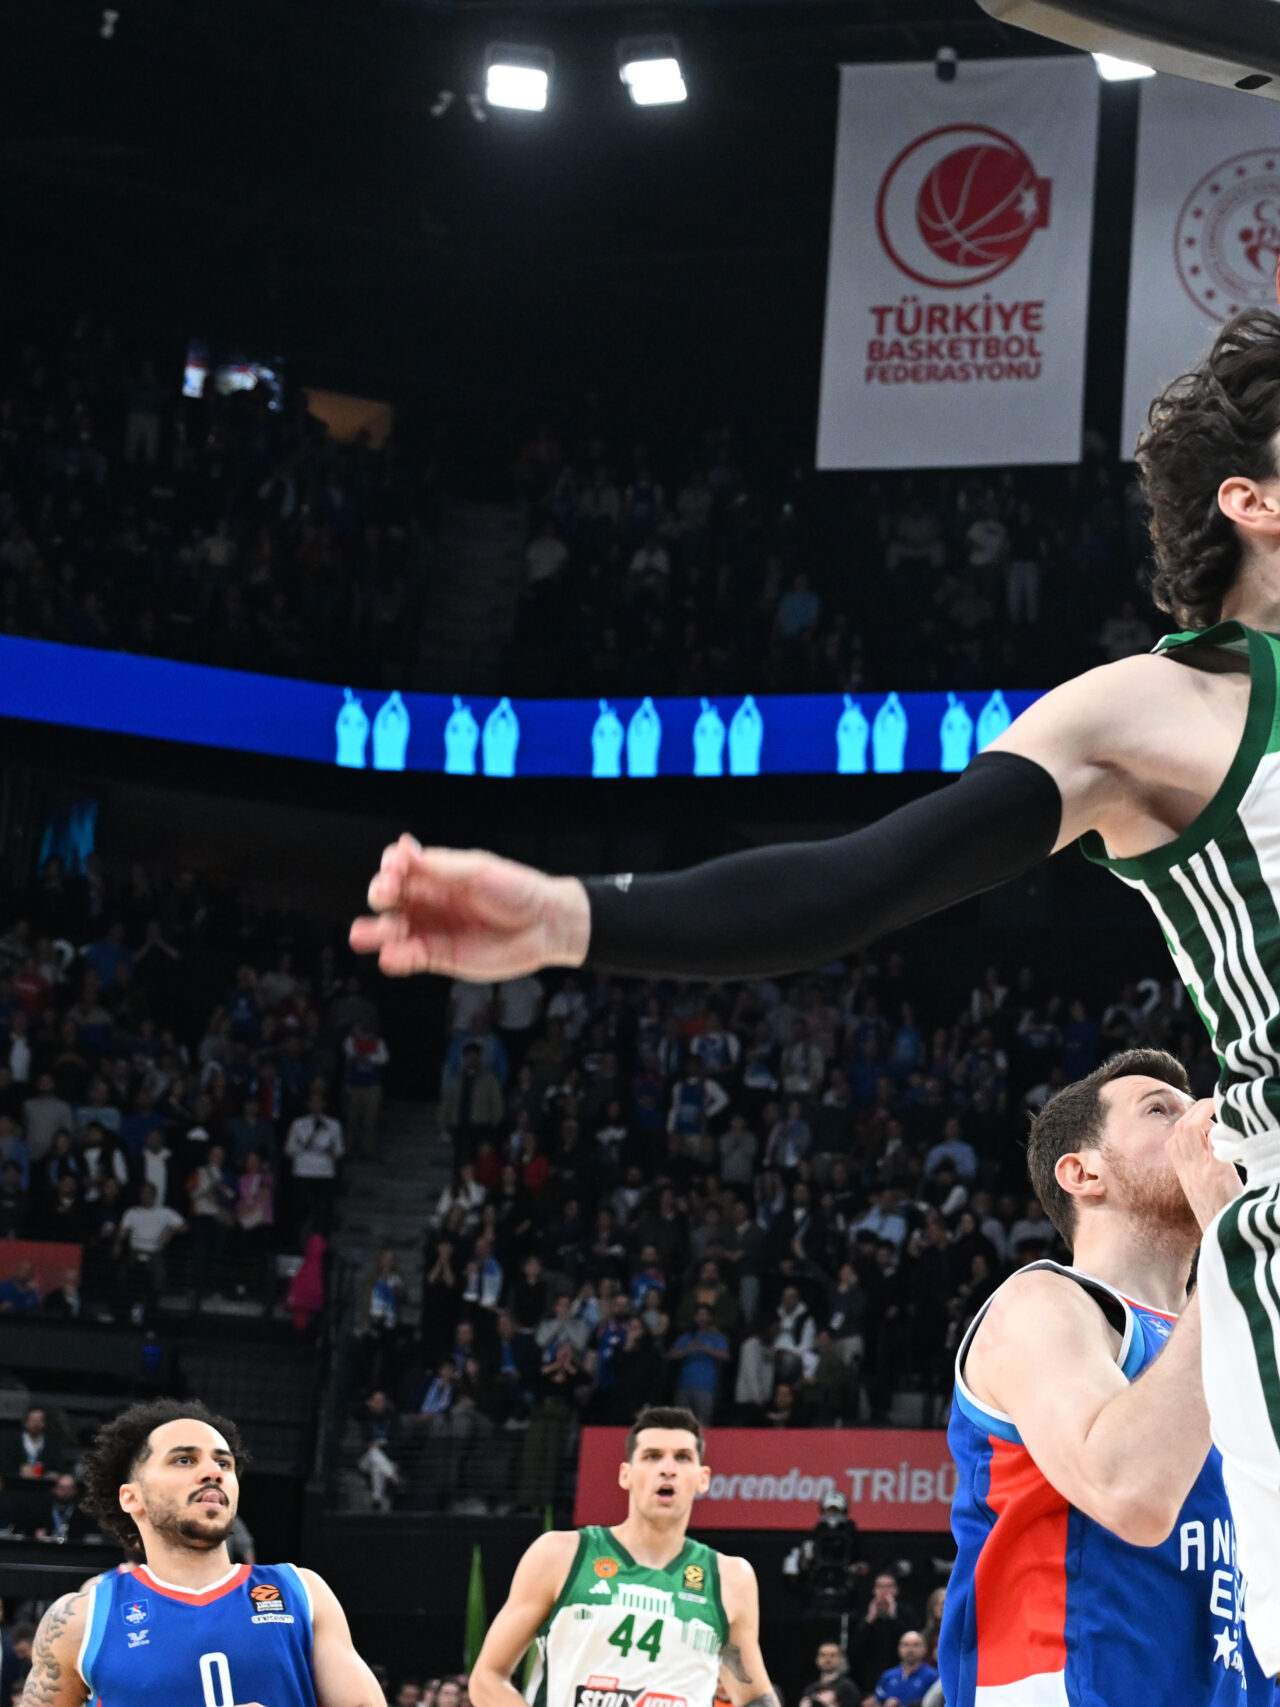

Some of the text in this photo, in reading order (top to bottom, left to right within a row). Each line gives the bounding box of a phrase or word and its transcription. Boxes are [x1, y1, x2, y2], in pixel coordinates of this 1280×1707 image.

[869, 292, 1045, 336] TÜRKİYE
[867, 333, 1043, 362] BASKETBOL
[864, 359, 1042, 385] FEDERASYONU
[695, 1467, 837, 1501] orendon
[608, 1613, 664, 1663] 44
